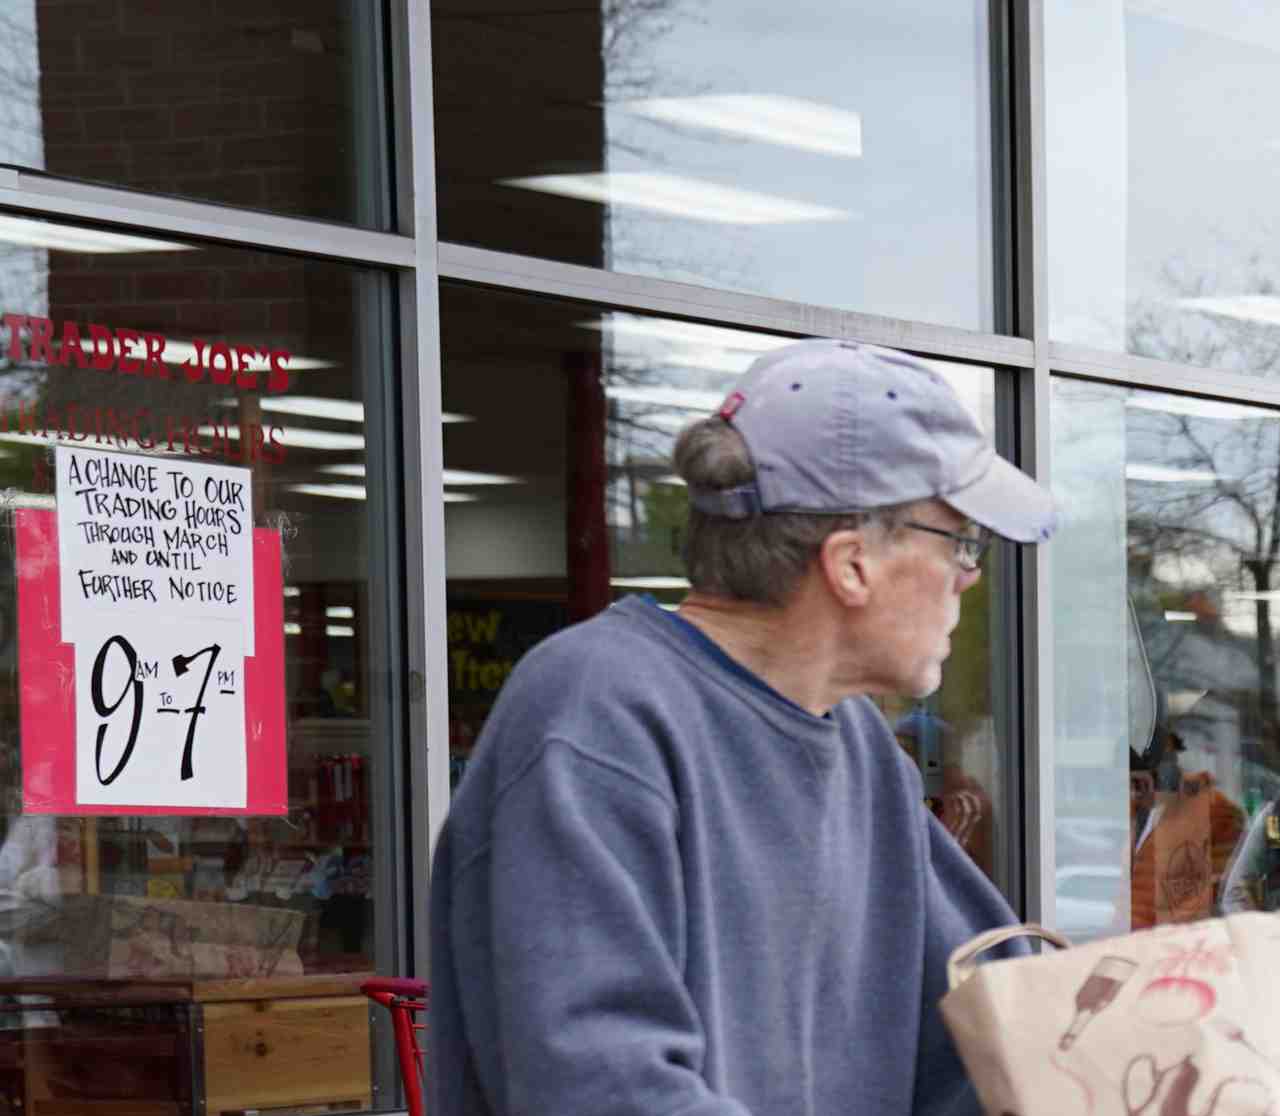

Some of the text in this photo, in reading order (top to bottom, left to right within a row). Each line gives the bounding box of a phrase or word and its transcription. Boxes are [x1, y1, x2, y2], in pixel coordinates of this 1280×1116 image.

[3, 314, 292, 393] TRADER JOE'S
[69, 454, 83, 487] A
[85, 457, 159, 493] CHANGE
[166, 471, 194, 500] TO
[204, 476, 246, 512] OUR
[75, 487, 242, 536] TRADING HOURS
[77, 521, 230, 557] THROUGH MARCH
[111, 548, 202, 571] AND UNTIL
[77, 569, 238, 604] FURTHER NOTICE
[91, 634, 145, 786] 9
[171, 642, 222, 781] 7
